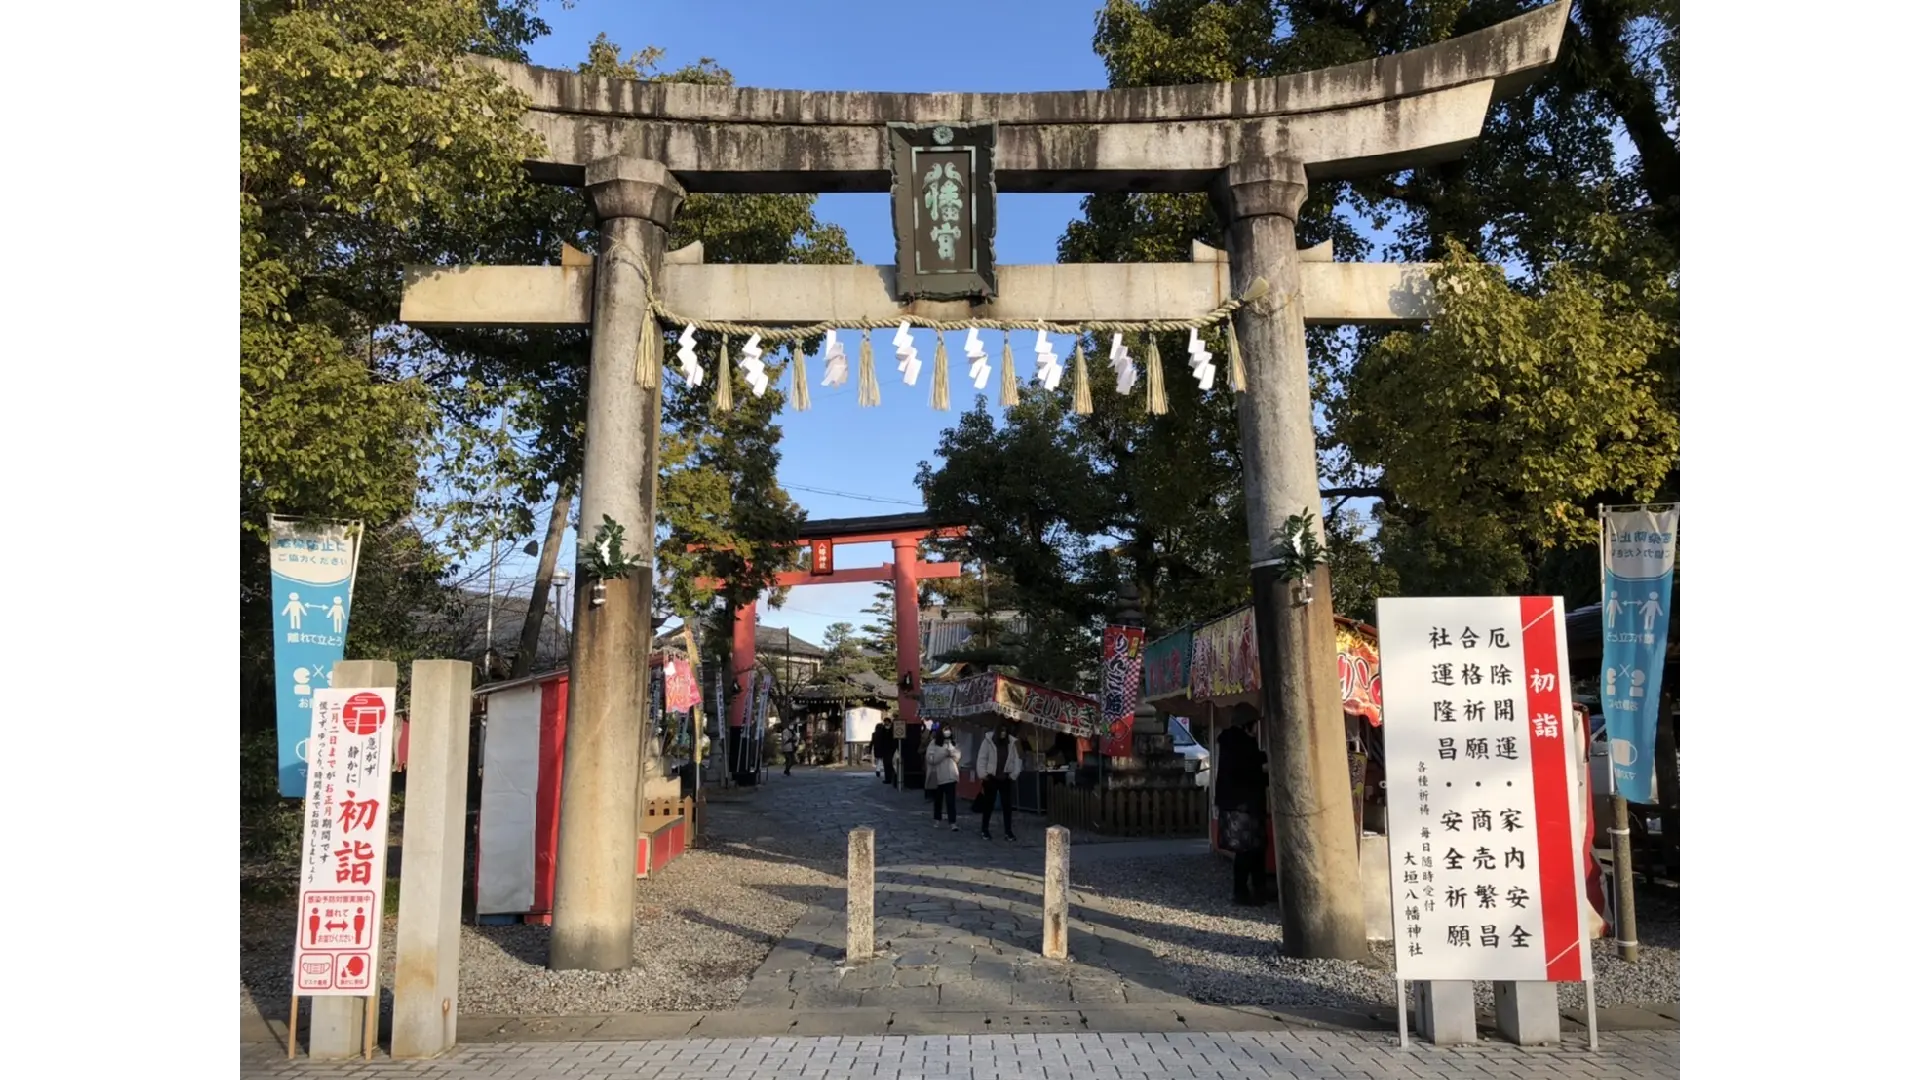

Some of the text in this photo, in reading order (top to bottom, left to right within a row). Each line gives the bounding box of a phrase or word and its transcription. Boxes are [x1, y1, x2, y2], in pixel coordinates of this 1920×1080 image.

[277, 553, 348, 566] ご協力ください
[1024, 688, 1098, 731] たいやき
[1529, 668, 1559, 739] 初詣
[346, 745, 359, 784] 静かに
[364, 737, 378, 776] 急がず
[1428, 626, 1472, 948] 社運隆昌・安全祈願
[1459, 626, 1500, 949] 合格祈願・商売繁昌
[1488, 626, 1533, 949] 厄除開運・家内安全
[334, 790, 380, 886] 初詣
[325, 909, 350, 918] 離れて
[1403, 851, 1423, 957] 大垣八幡神社
